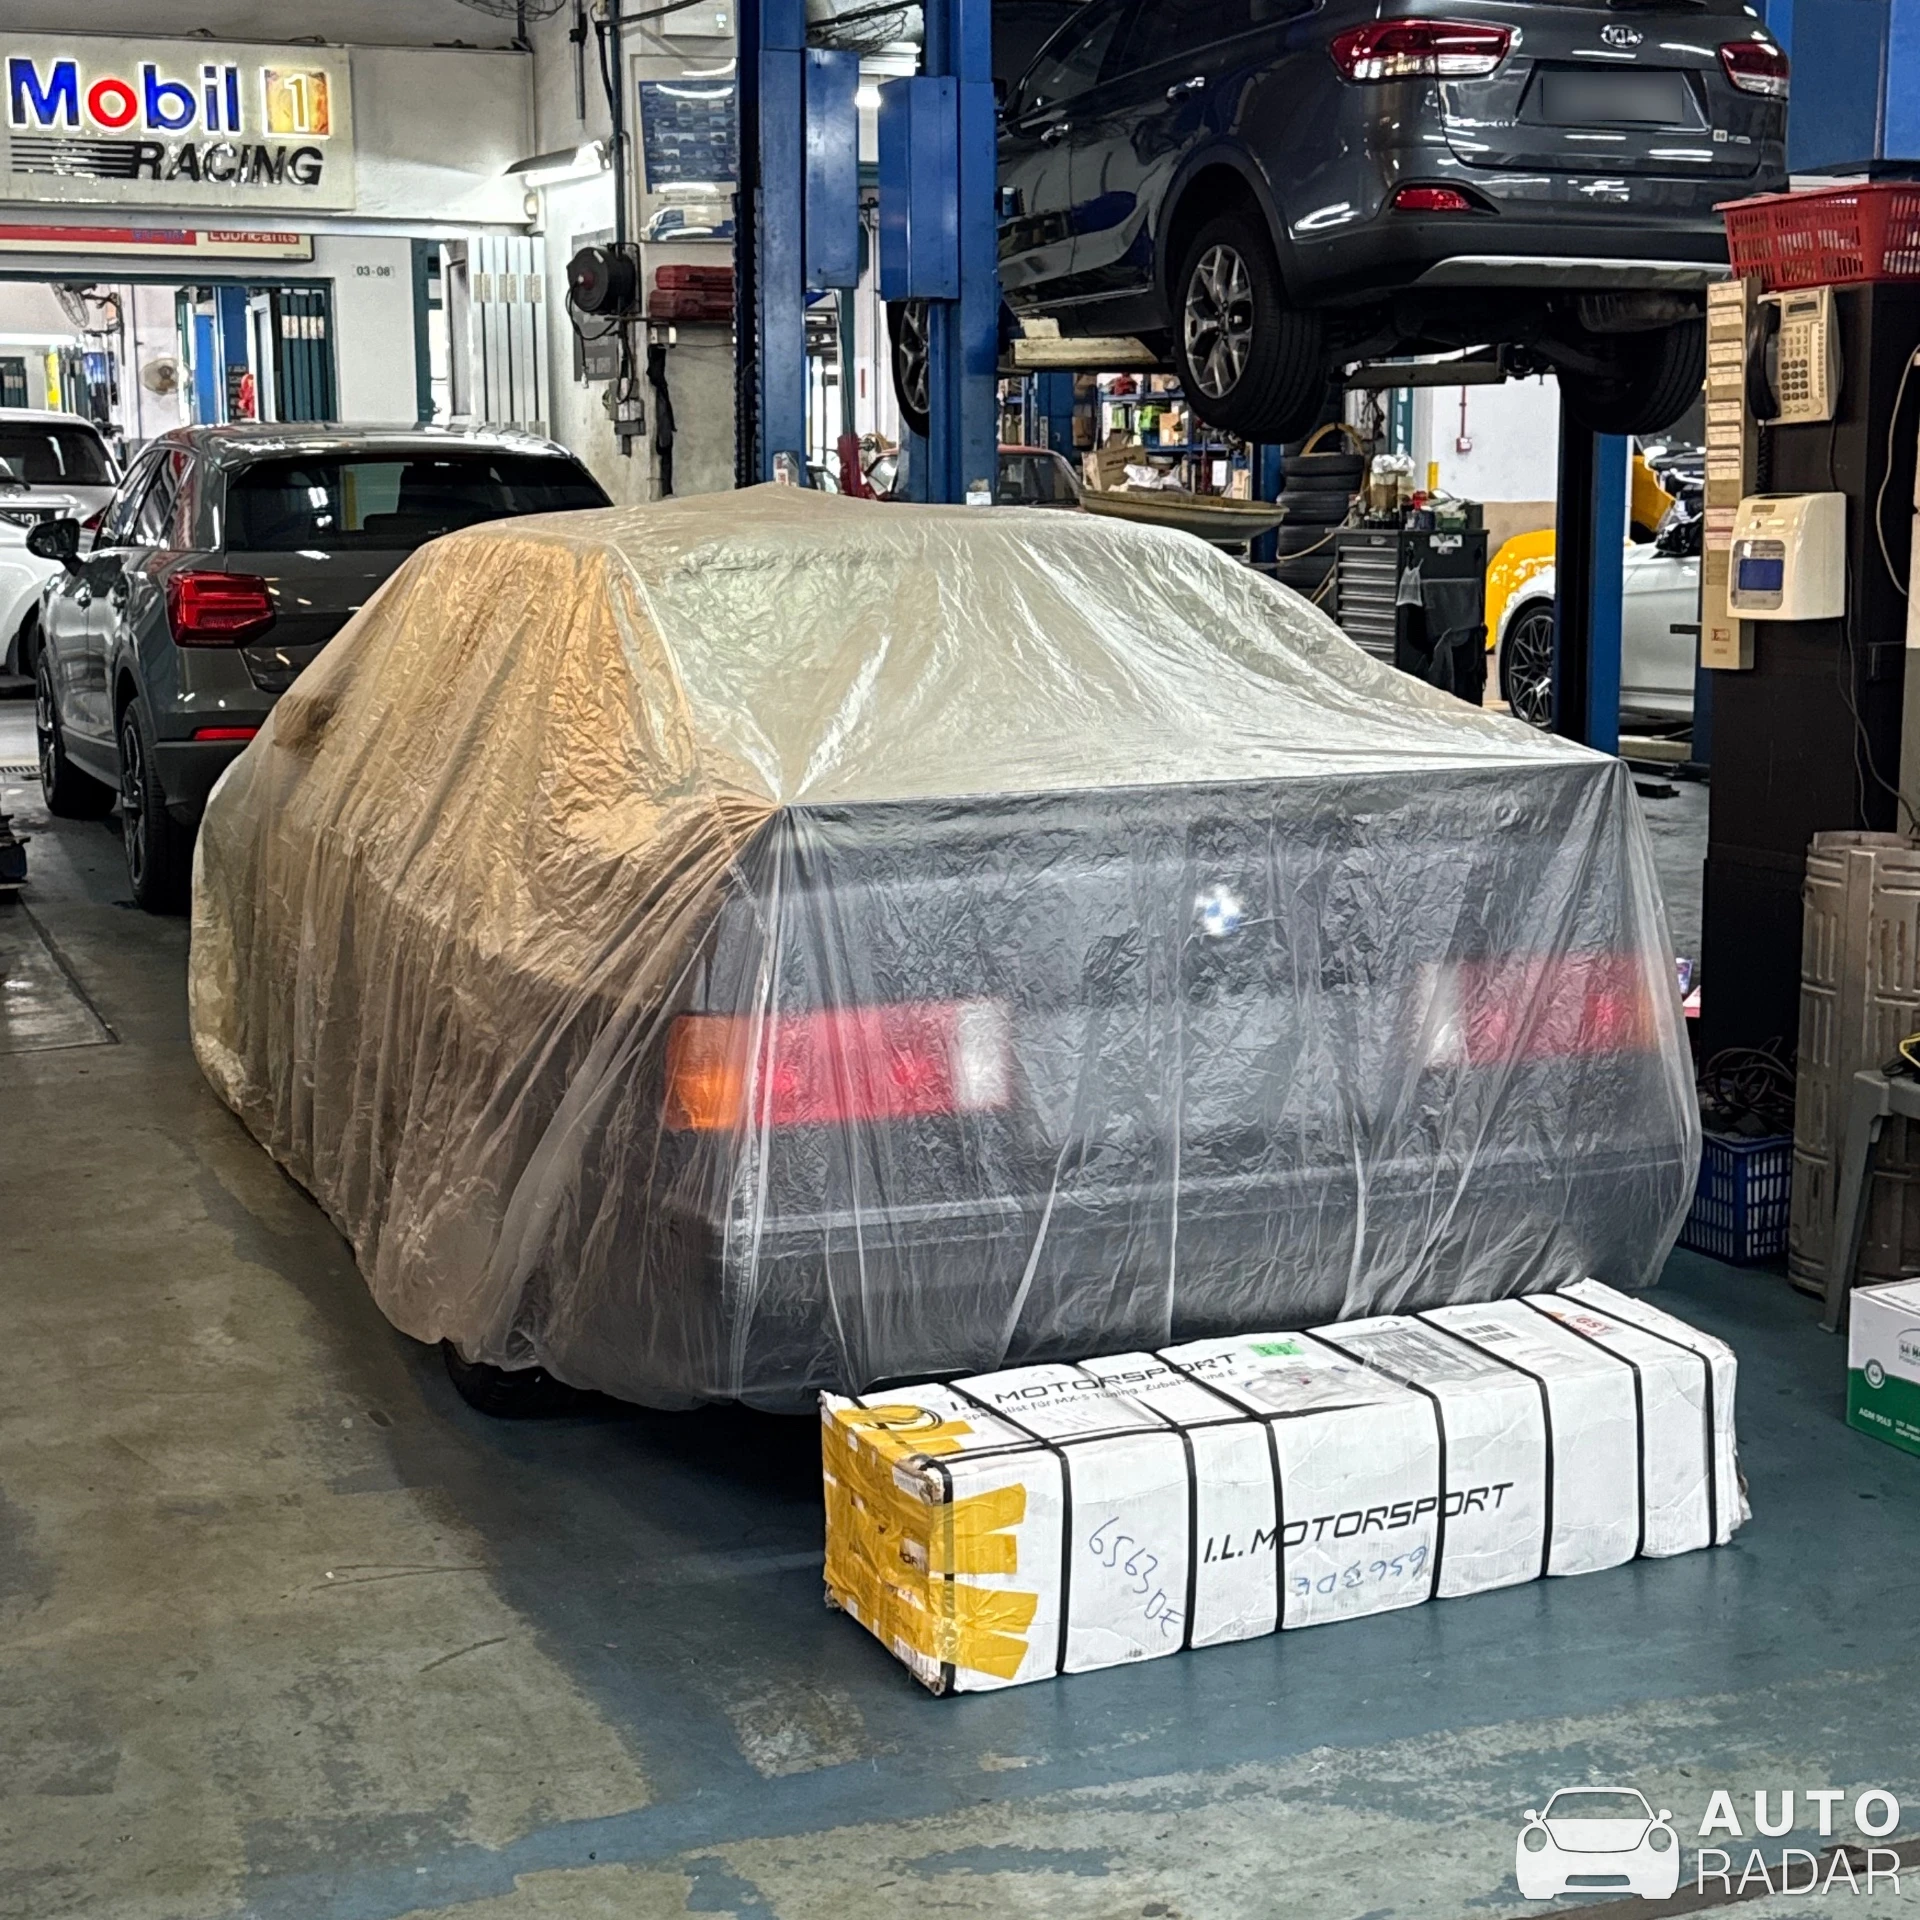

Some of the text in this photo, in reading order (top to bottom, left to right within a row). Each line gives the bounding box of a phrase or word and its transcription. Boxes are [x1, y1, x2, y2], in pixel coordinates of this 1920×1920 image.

[1606, 27, 1639, 45] KIA
[7, 56, 242, 136] Mobil
[132, 140, 324, 186] RACING
[994, 1353, 1236, 1404] MOTORSPORT
[1204, 1482, 1514, 1563] I.L. MOTORSPORT
